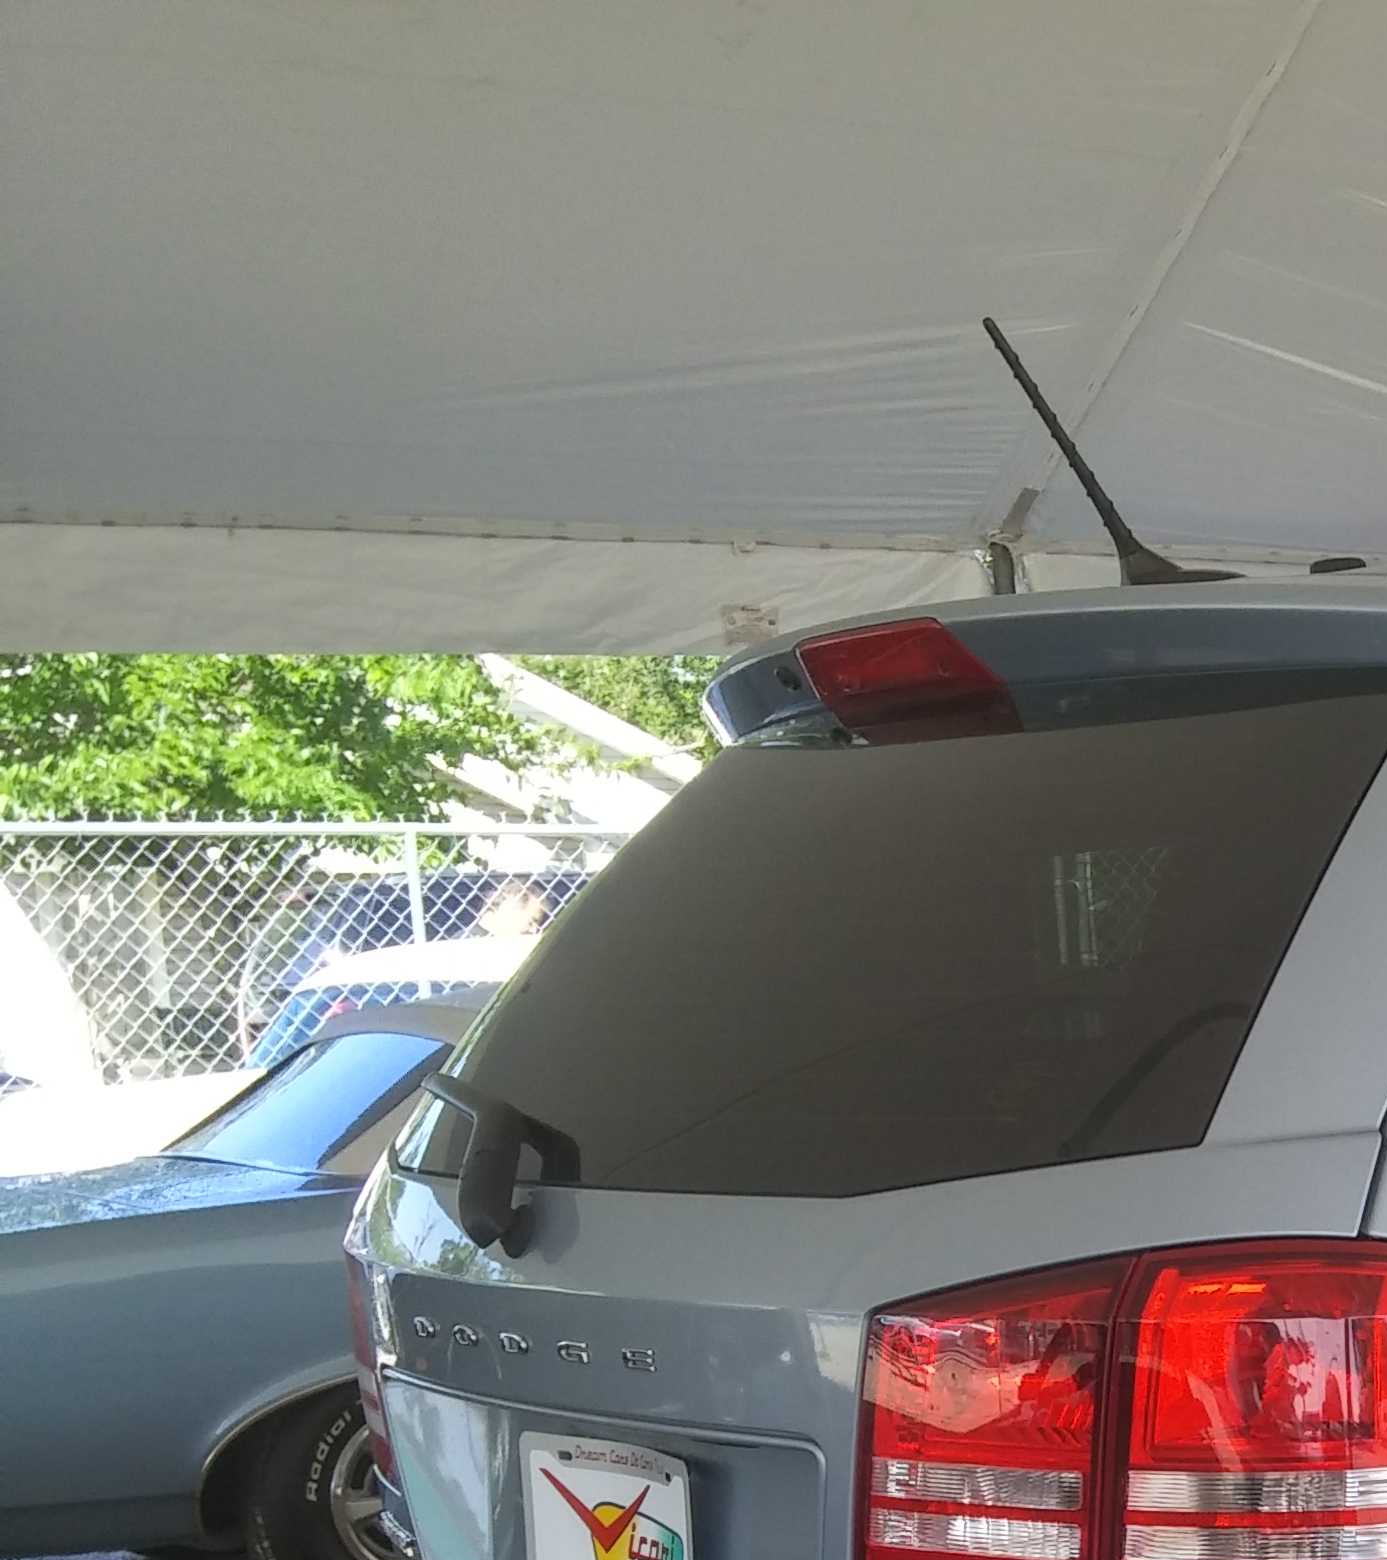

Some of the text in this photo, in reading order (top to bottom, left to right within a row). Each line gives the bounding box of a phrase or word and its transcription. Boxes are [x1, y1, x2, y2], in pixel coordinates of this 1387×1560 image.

[412, 1315, 658, 1373] DODGE
[305, 1410, 352, 1502] Radial
[575, 1445, 607, 1463] Dream
